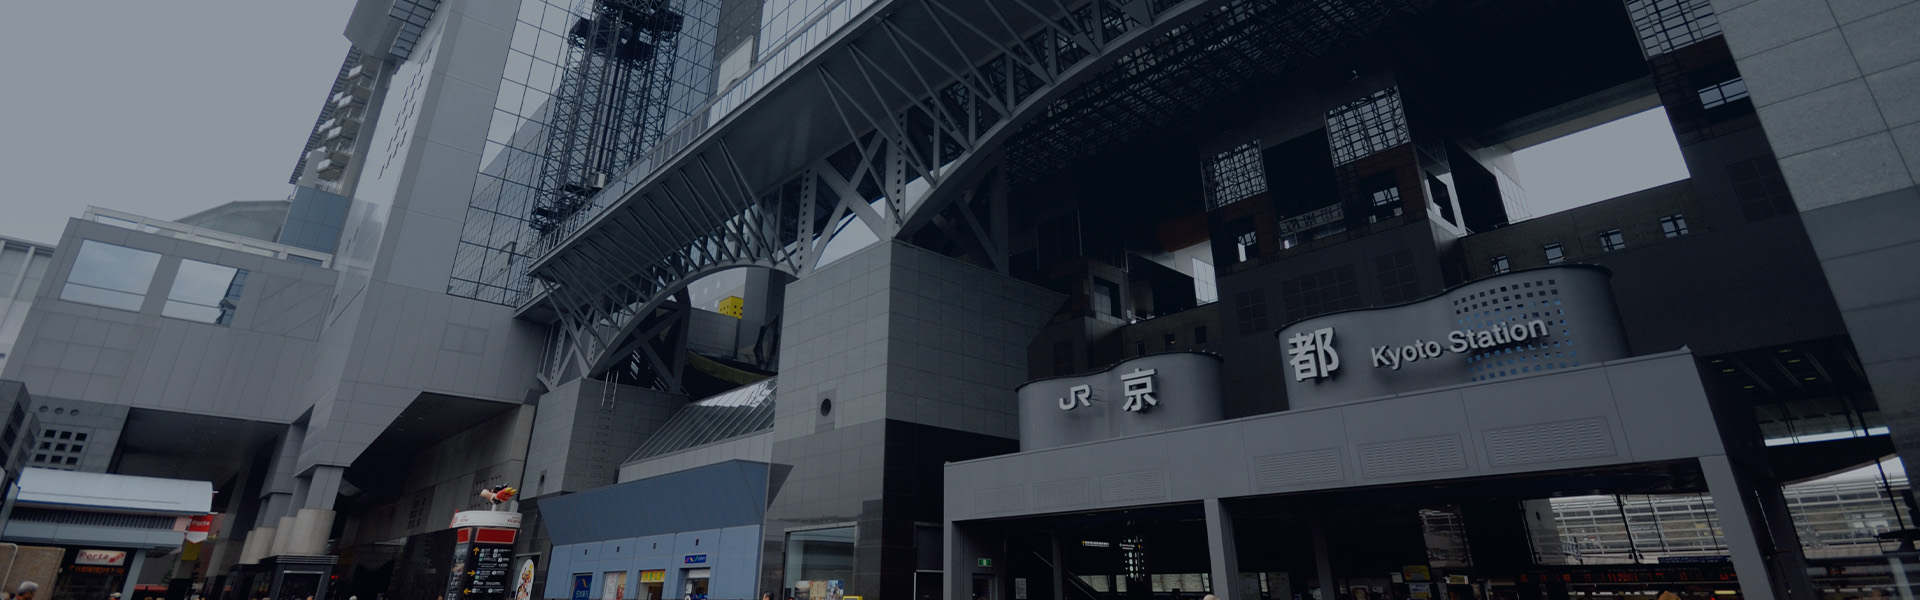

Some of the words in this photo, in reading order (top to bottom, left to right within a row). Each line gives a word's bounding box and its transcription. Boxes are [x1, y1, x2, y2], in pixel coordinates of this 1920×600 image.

[1288, 326, 1340, 382] 都
[1370, 339, 1442, 370] Kyoto
[1447, 318, 1549, 354] Station
[1058, 383, 1092, 411] JR
[1120, 367, 1157, 413] 京
[79, 551, 109, 560] Porta
